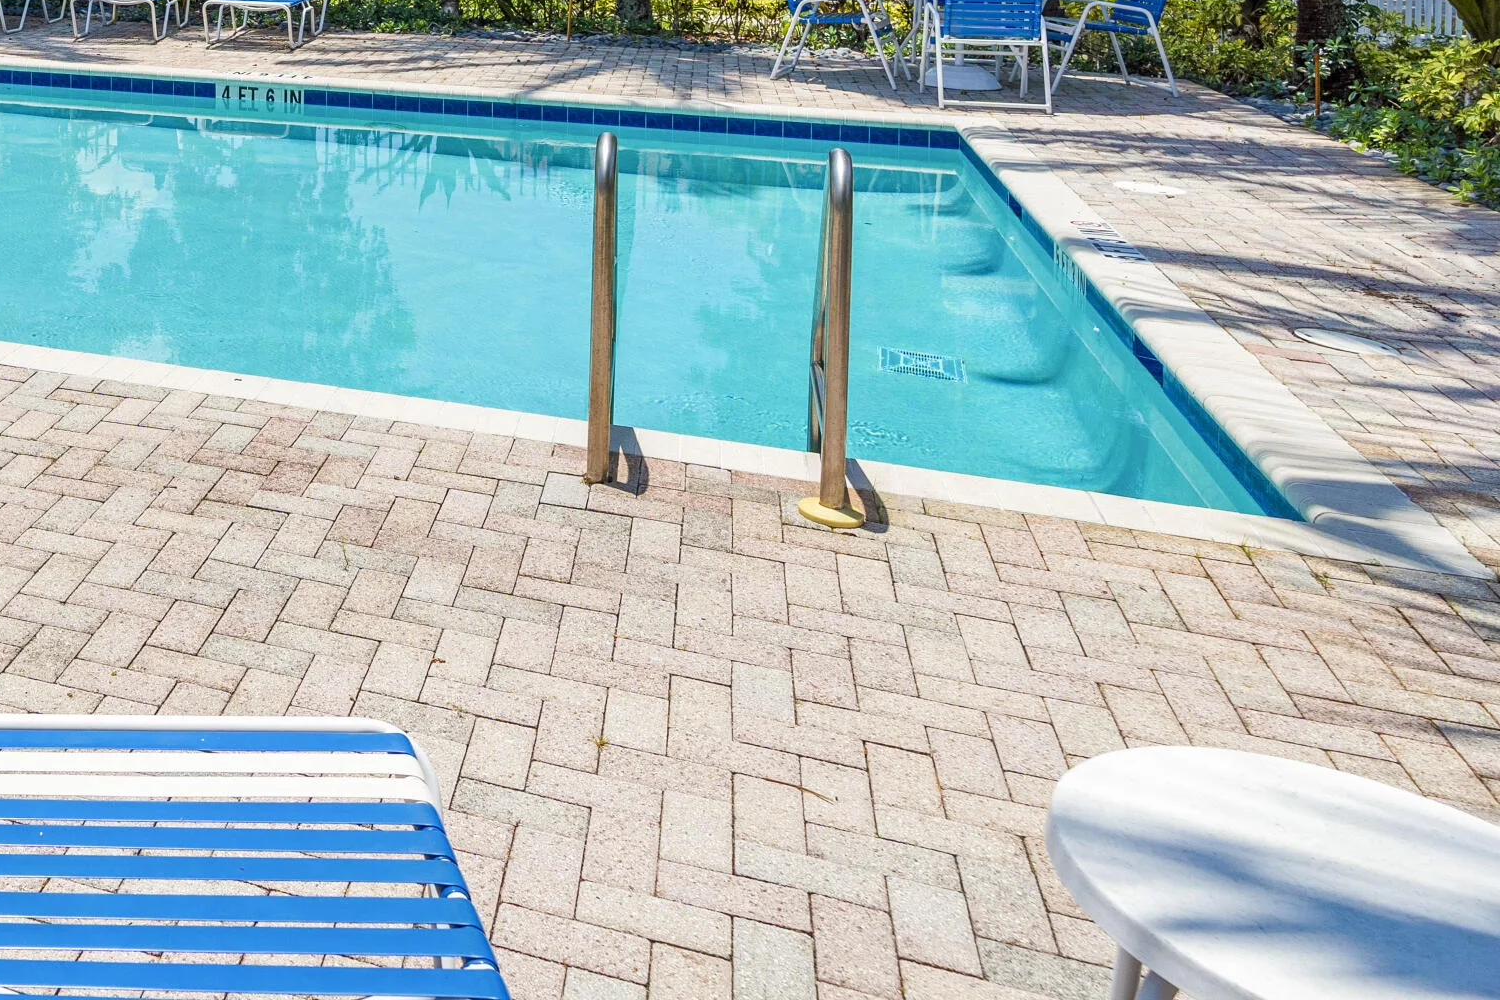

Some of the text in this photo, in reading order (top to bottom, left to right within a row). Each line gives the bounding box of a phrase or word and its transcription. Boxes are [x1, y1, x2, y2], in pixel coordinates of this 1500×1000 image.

[221, 85, 302, 104] 4 FT 6 IN
